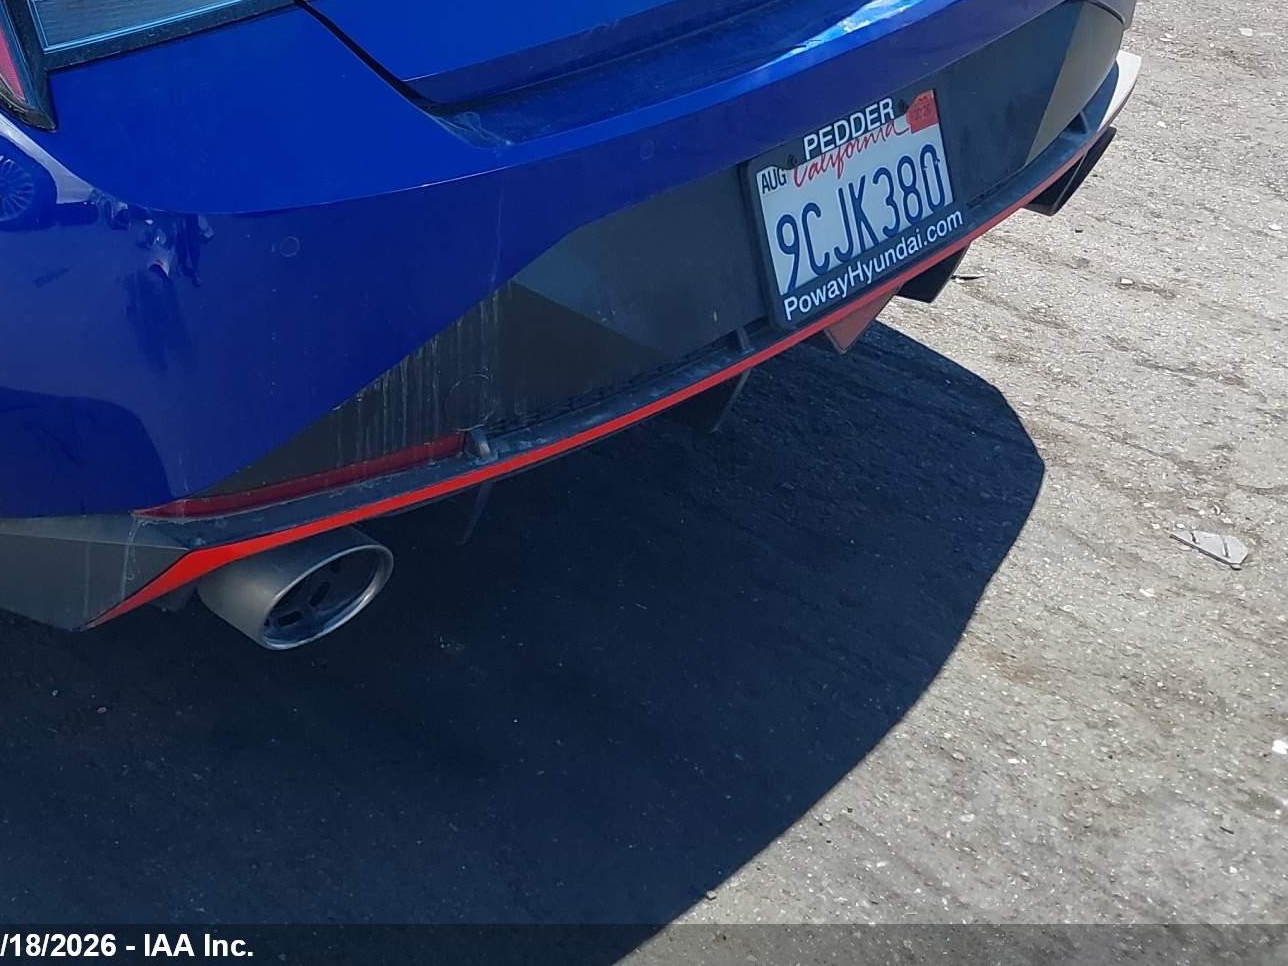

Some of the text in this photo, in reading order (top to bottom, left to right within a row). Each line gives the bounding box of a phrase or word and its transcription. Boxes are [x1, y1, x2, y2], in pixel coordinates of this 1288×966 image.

[793, 120, 910, 188] California
[803, 97, 895, 161] PEDDER
[762, 167, 787, 194] AUG
[776, 143, 946, 291] 9CJK380
[783, 209, 964, 321] PowayHyundai.com
